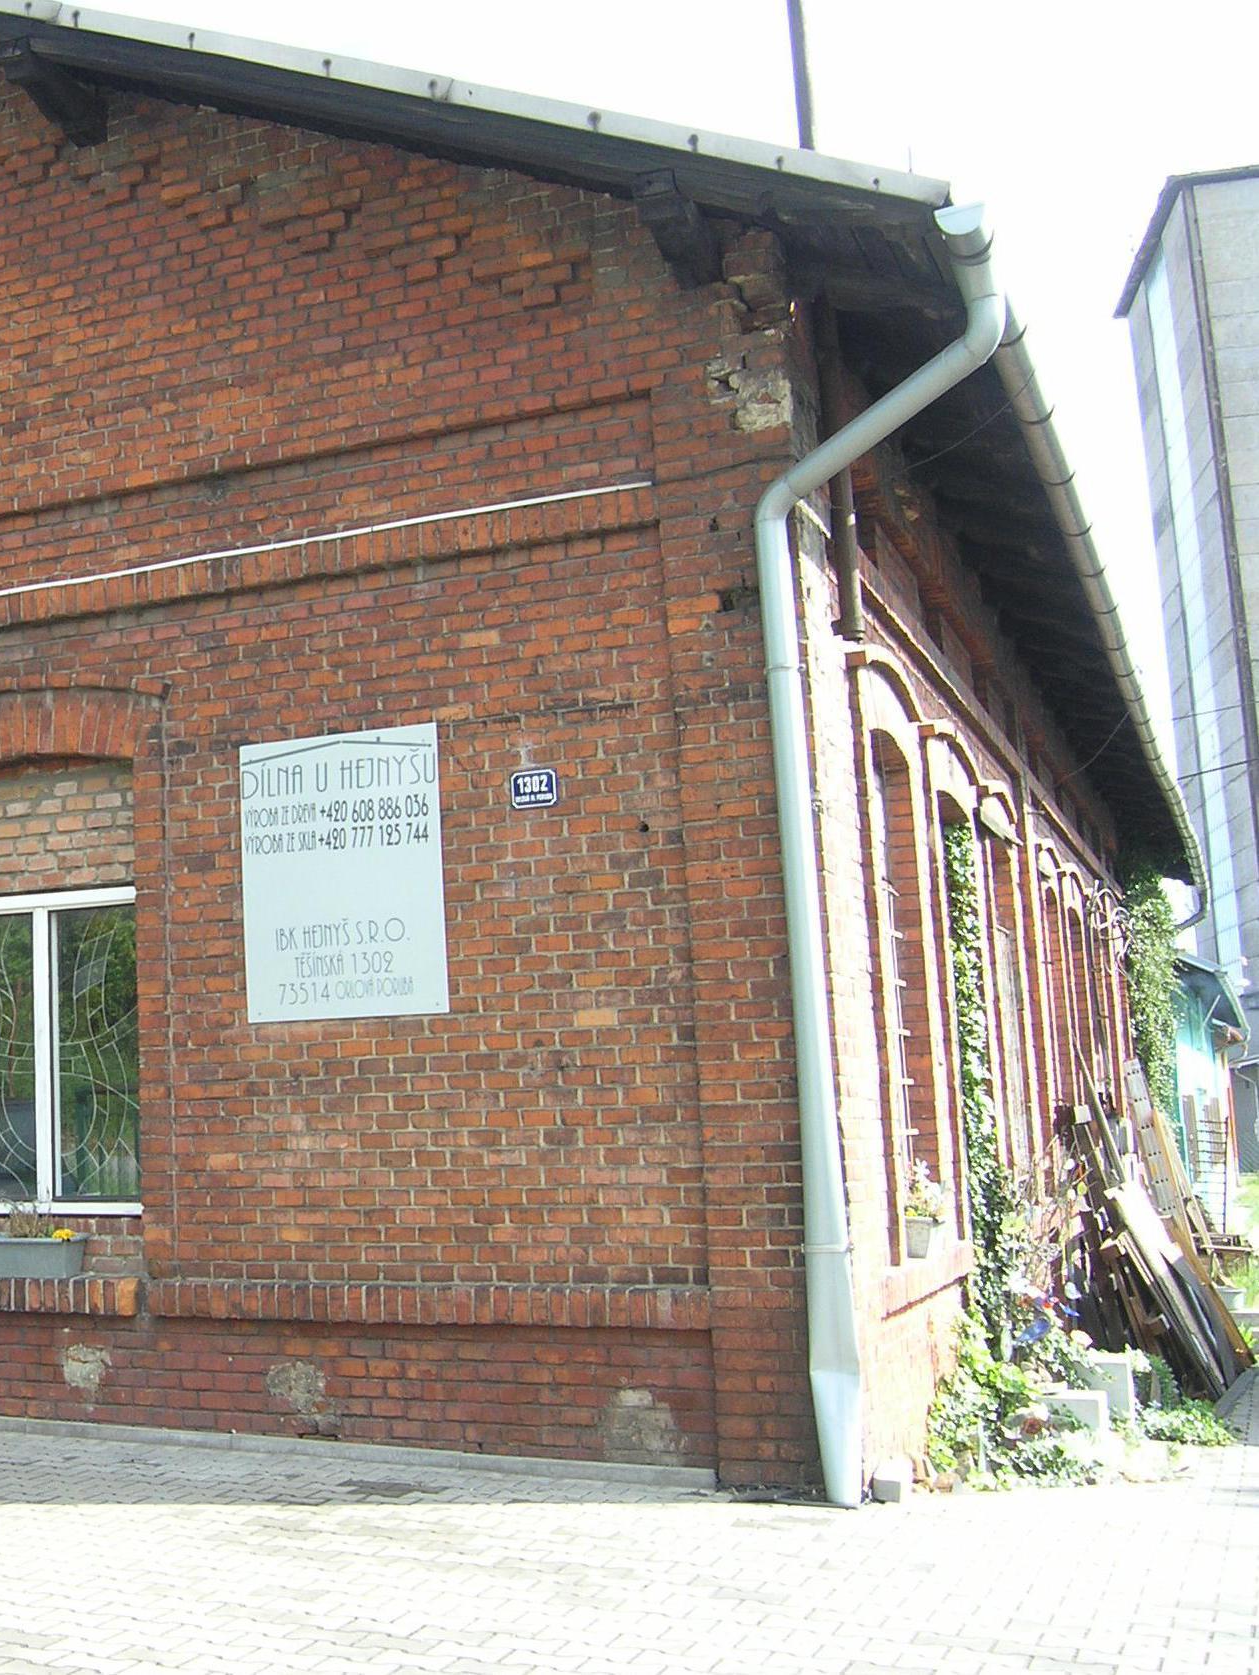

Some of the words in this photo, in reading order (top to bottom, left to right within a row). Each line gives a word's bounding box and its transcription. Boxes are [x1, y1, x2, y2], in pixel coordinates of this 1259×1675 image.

[241, 763, 303, 800] DÍLNA
[315, 762, 329, 793] U
[516, 774, 549, 793] 1302
[244, 804, 279, 829] VÝROBA
[281, 805, 290, 826] ZE
[320, 800, 347, 823] +420
[351, 799, 375, 823] 608
[378, 796, 402, 821] 886
[405, 793, 430, 819] 036
[244, 832, 283, 855] VÝROBA
[286, 831, 295, 853] ZE
[298, 830, 317, 852] SKLA
[318, 827, 346, 850] +420
[351, 825, 374, 848] 777
[379, 823, 402, 846] 125
[406, 821, 429, 845] 744
[275, 926, 299, 952] IBK
[302, 918, 351, 950] HEJNYŠ
[356, 917, 411, 946] S.R.O.
[294, 950, 345, 979] TĚŠÍNSKÁ
[352, 951, 394, 976] 1302
[279, 982, 331, 1006] 73514
